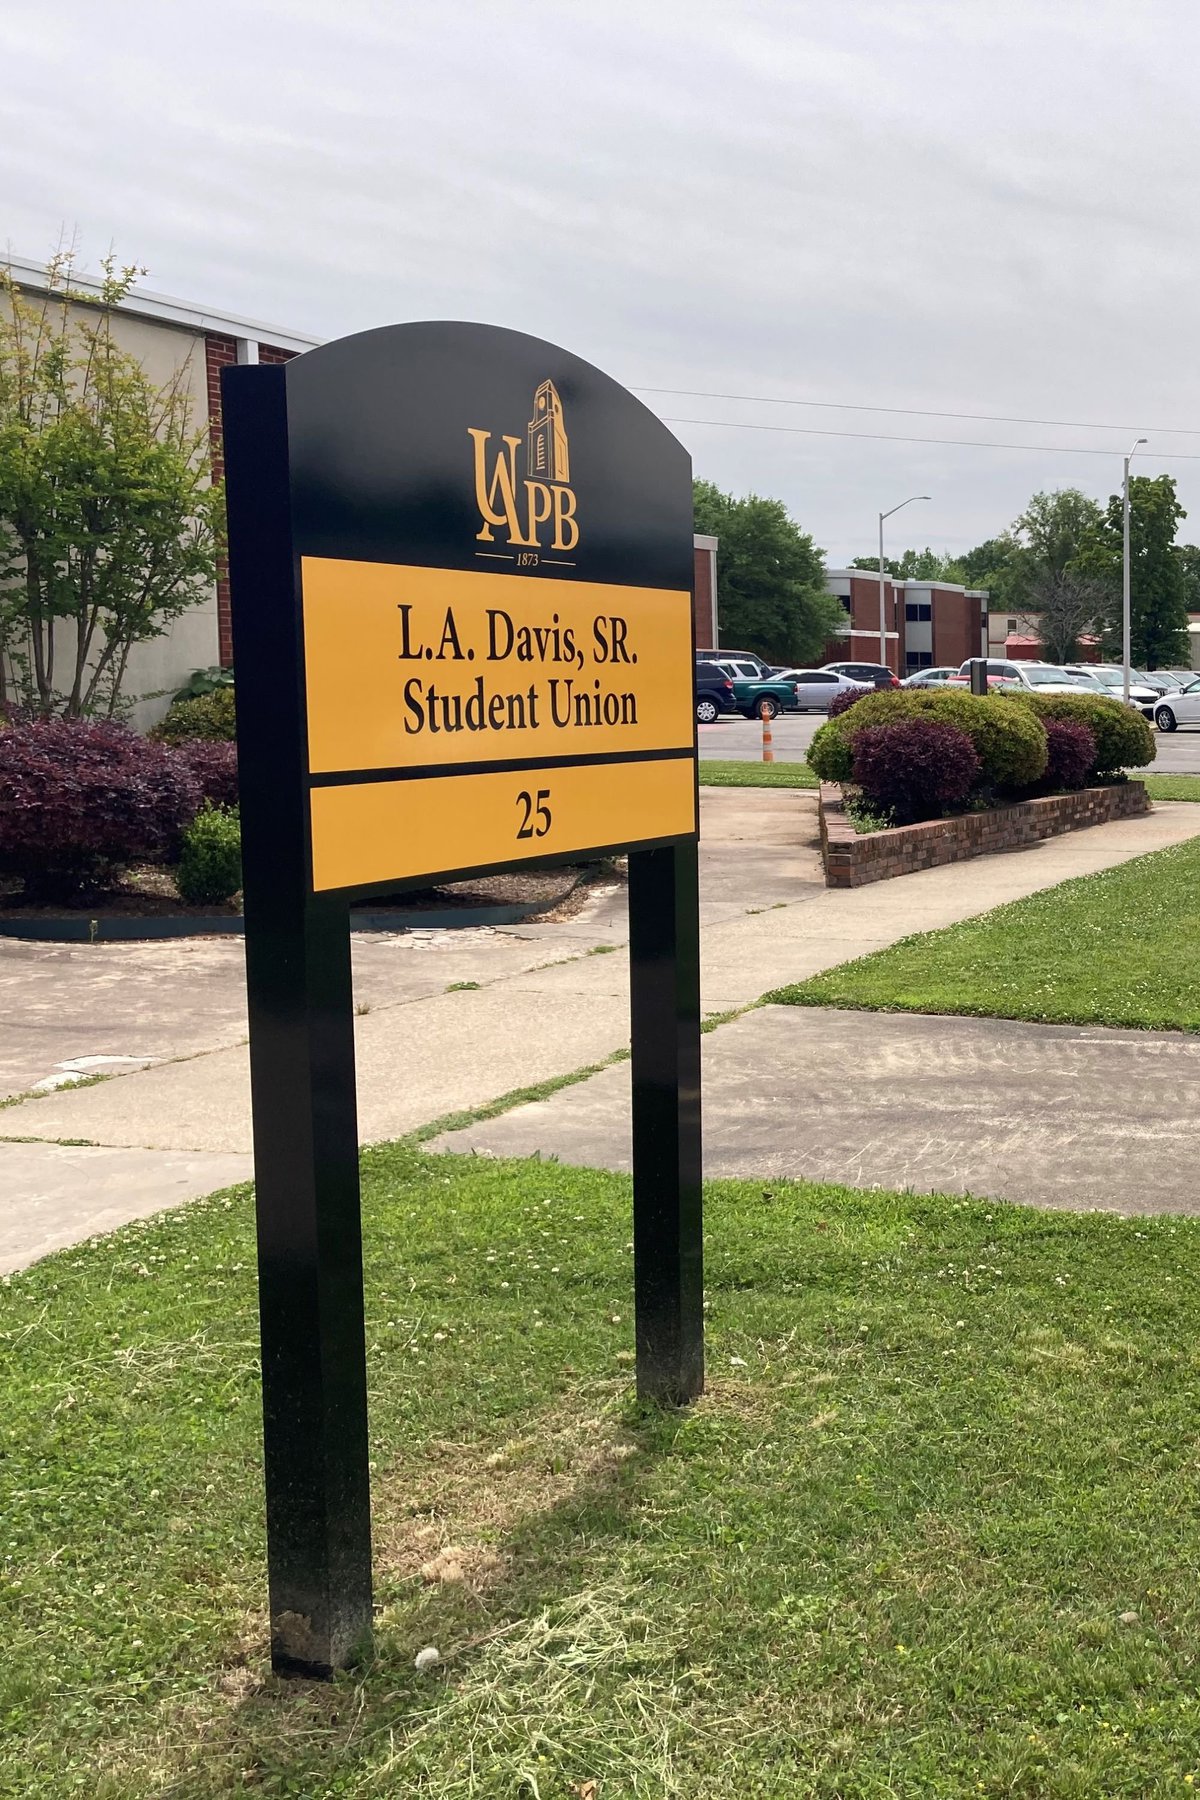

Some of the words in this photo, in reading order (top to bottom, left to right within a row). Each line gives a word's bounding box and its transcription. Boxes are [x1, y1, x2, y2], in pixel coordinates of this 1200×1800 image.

[516, 553, 539, 567] 1873
[397, 604, 475, 661] L.A.
[486, 609, 584, 671] Davis,
[593, 615, 638, 665] SR.
[403, 676, 540, 735] Student
[548, 678, 638, 728] Union
[515, 789, 552, 840] 25
